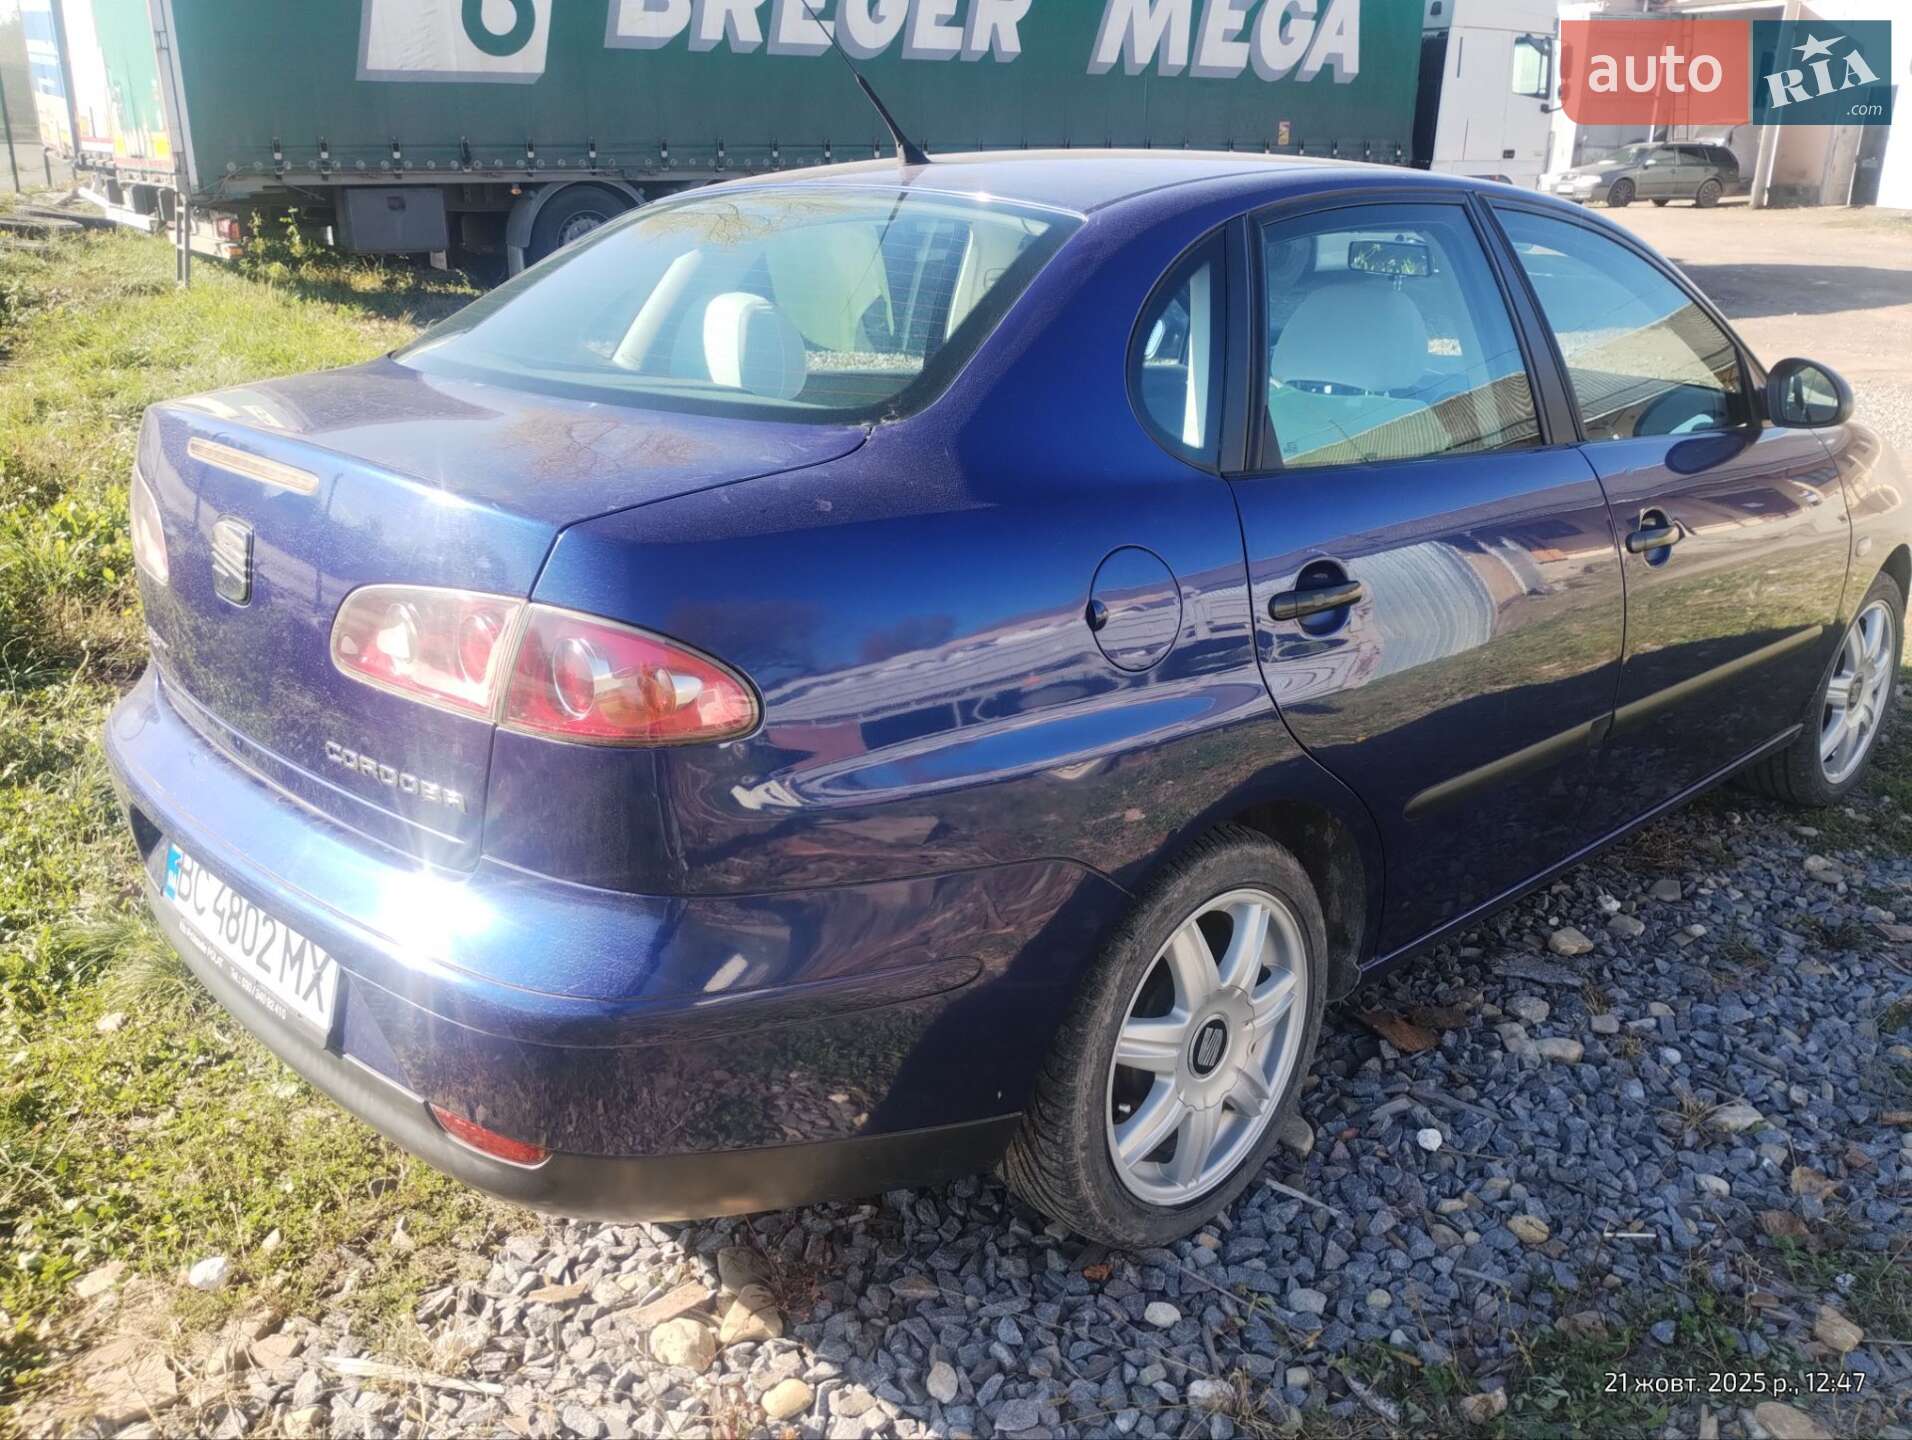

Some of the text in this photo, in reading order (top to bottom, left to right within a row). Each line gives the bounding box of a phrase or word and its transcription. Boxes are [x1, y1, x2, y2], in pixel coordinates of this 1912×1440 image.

[1086, 0, 1360, 84] MEGA
[212, 884, 277, 974] 4802
[279, 928, 332, 1013] MX
